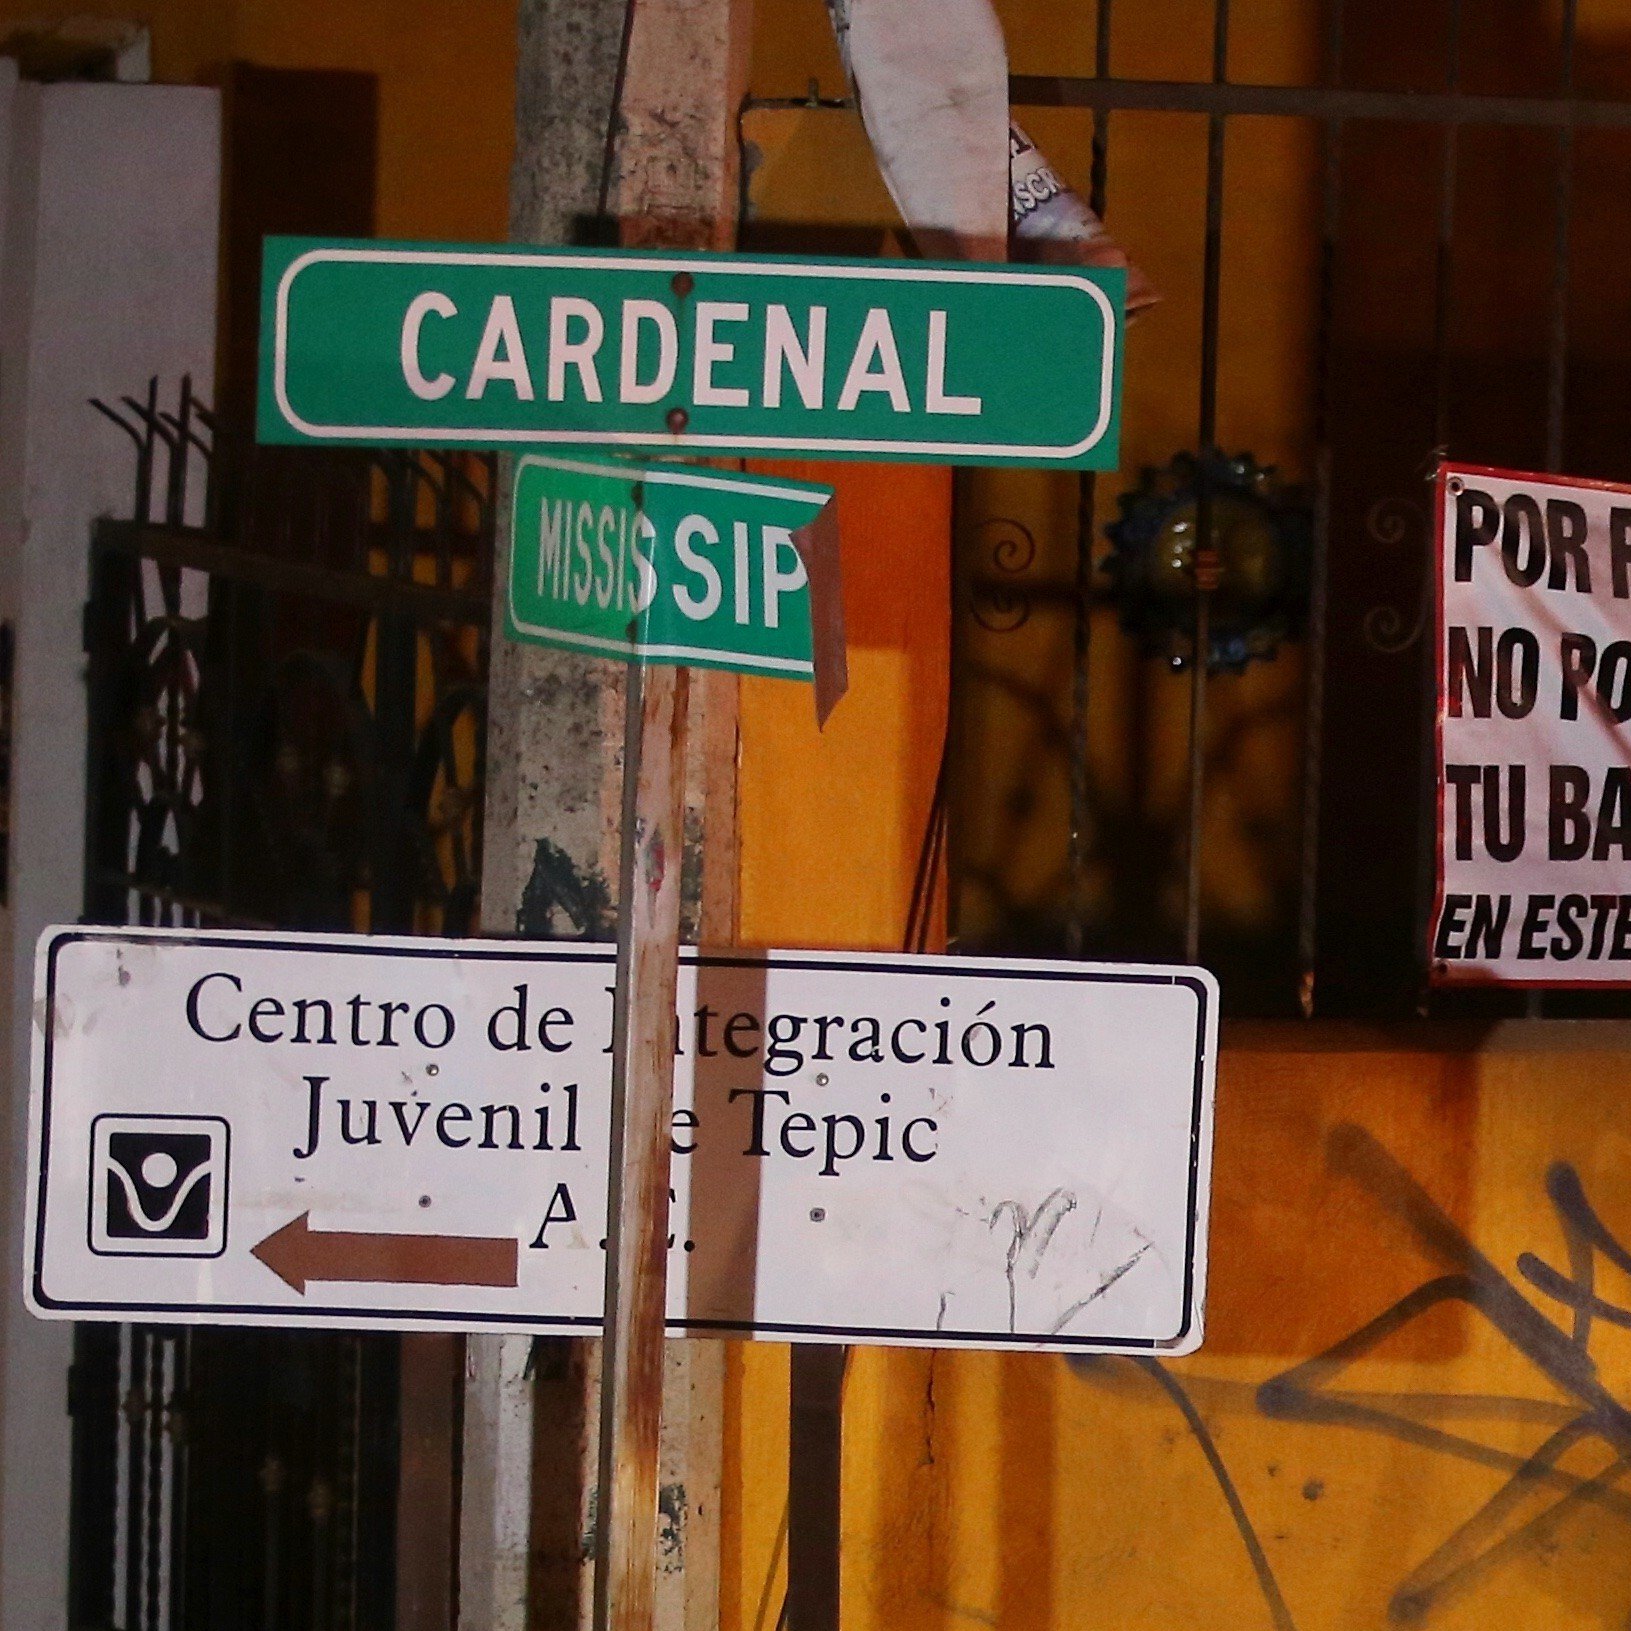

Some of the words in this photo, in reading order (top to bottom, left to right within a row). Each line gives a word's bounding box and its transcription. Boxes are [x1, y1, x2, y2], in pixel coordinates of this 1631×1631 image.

[400, 290, 983, 416] CARDENAL
[537, 496, 809, 629] MISSISSIP
[1454, 488, 1592, 594] POR
[1447, 626, 1540, 721] NO
[1445, 764, 1527, 863] TU
[1435, 893, 1511, 960] EN
[186, 972, 456, 1050] Centro
[487, 984, 574, 1053] de
[293, 1075, 582, 1159] Juvenil
[729, 1088, 938, 1177] Tepic
